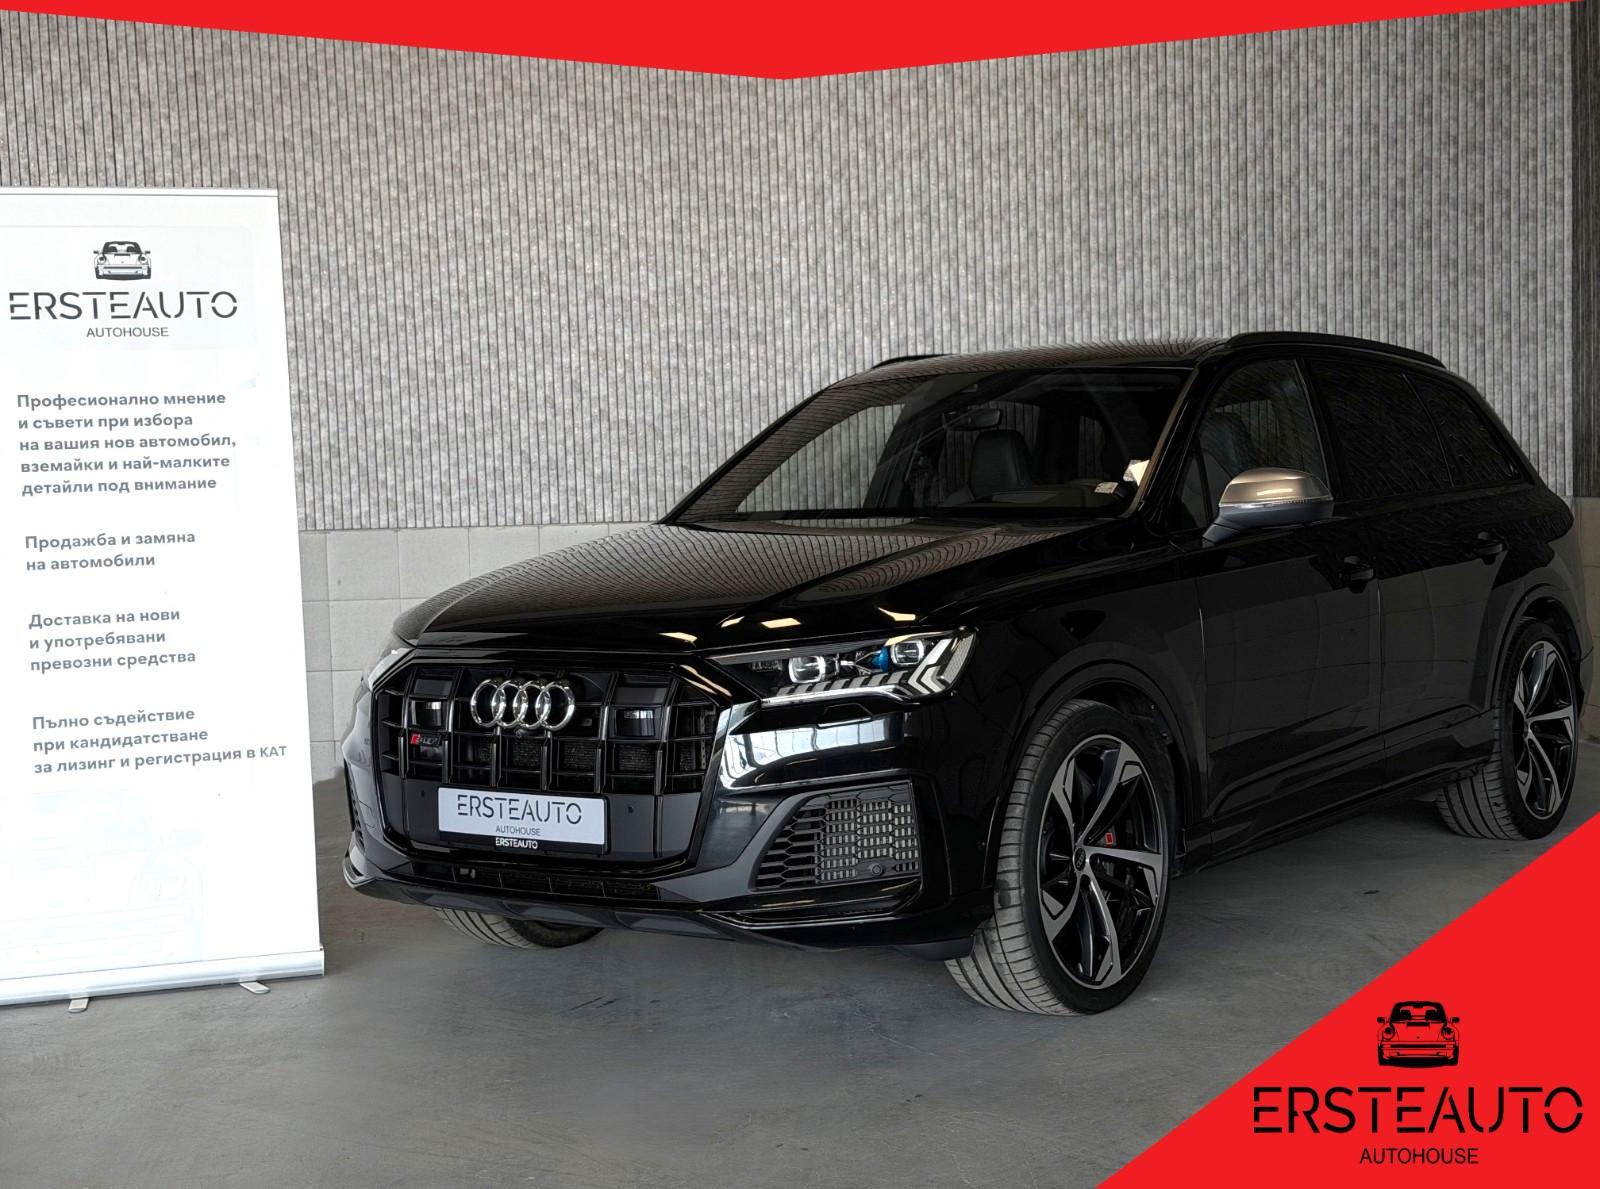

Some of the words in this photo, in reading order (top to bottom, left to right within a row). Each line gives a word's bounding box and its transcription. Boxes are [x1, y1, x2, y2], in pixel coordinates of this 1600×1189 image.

[8, 290, 238, 321] ERSTEAUTO
[85, 326, 169, 338] AUTOHOUSE
[16, 393, 160, 412] Професионално
[163, 394, 226, 405] мнение
[18, 419, 29, 430] и
[32, 418, 94, 429] съвети
[97, 417, 129, 431] при
[133, 412, 193, 429] избора
[19, 441, 40, 451] на
[43, 439, 100, 451] вашия
[104, 438, 135, 449] нов
[138, 432, 237, 448] автомобил,
[20, 457, 104, 473] вземайки
[108, 460, 118, 471] и
[122, 455, 230, 470] най-малките
[21, 479, 94, 497] детайли
[97, 481, 131, 494] под
[134, 479, 217, 491] внимание
[25, 532, 117, 553] Продажба
[120, 535, 131, 546] и
[135, 533, 196, 545] замяна
[26, 560, 46, 572] на
[50, 553, 156, 571] автомобили
[28, 613, 112, 631] Доставка
[115, 612, 136, 623] на
[139, 610, 180, 622] нови
[29, 639, 40, 650] и
[43, 631, 166, 653] употребявани
[30, 657, 113, 675] превозни
[116, 652, 196, 670] средства
[32, 716, 90, 730] Пълно
[93, 709, 196, 727] съдействие
[33, 740, 65, 756] при
[69, 730, 209, 750] кандидатстване
[34, 763, 53, 774] за
[56, 758, 116, 773] лизинг
[120, 757, 130, 768] и
[134, 749, 242, 771] регистрация
[246, 748, 256, 759] в
[259, 745, 288, 758] КАТ
[457, 794, 582, 825] ERSTEAUTO
[495, 825, 541, 837] AUTOHOUSE
[495, 837, 538, 849] ERSTEAUTO
